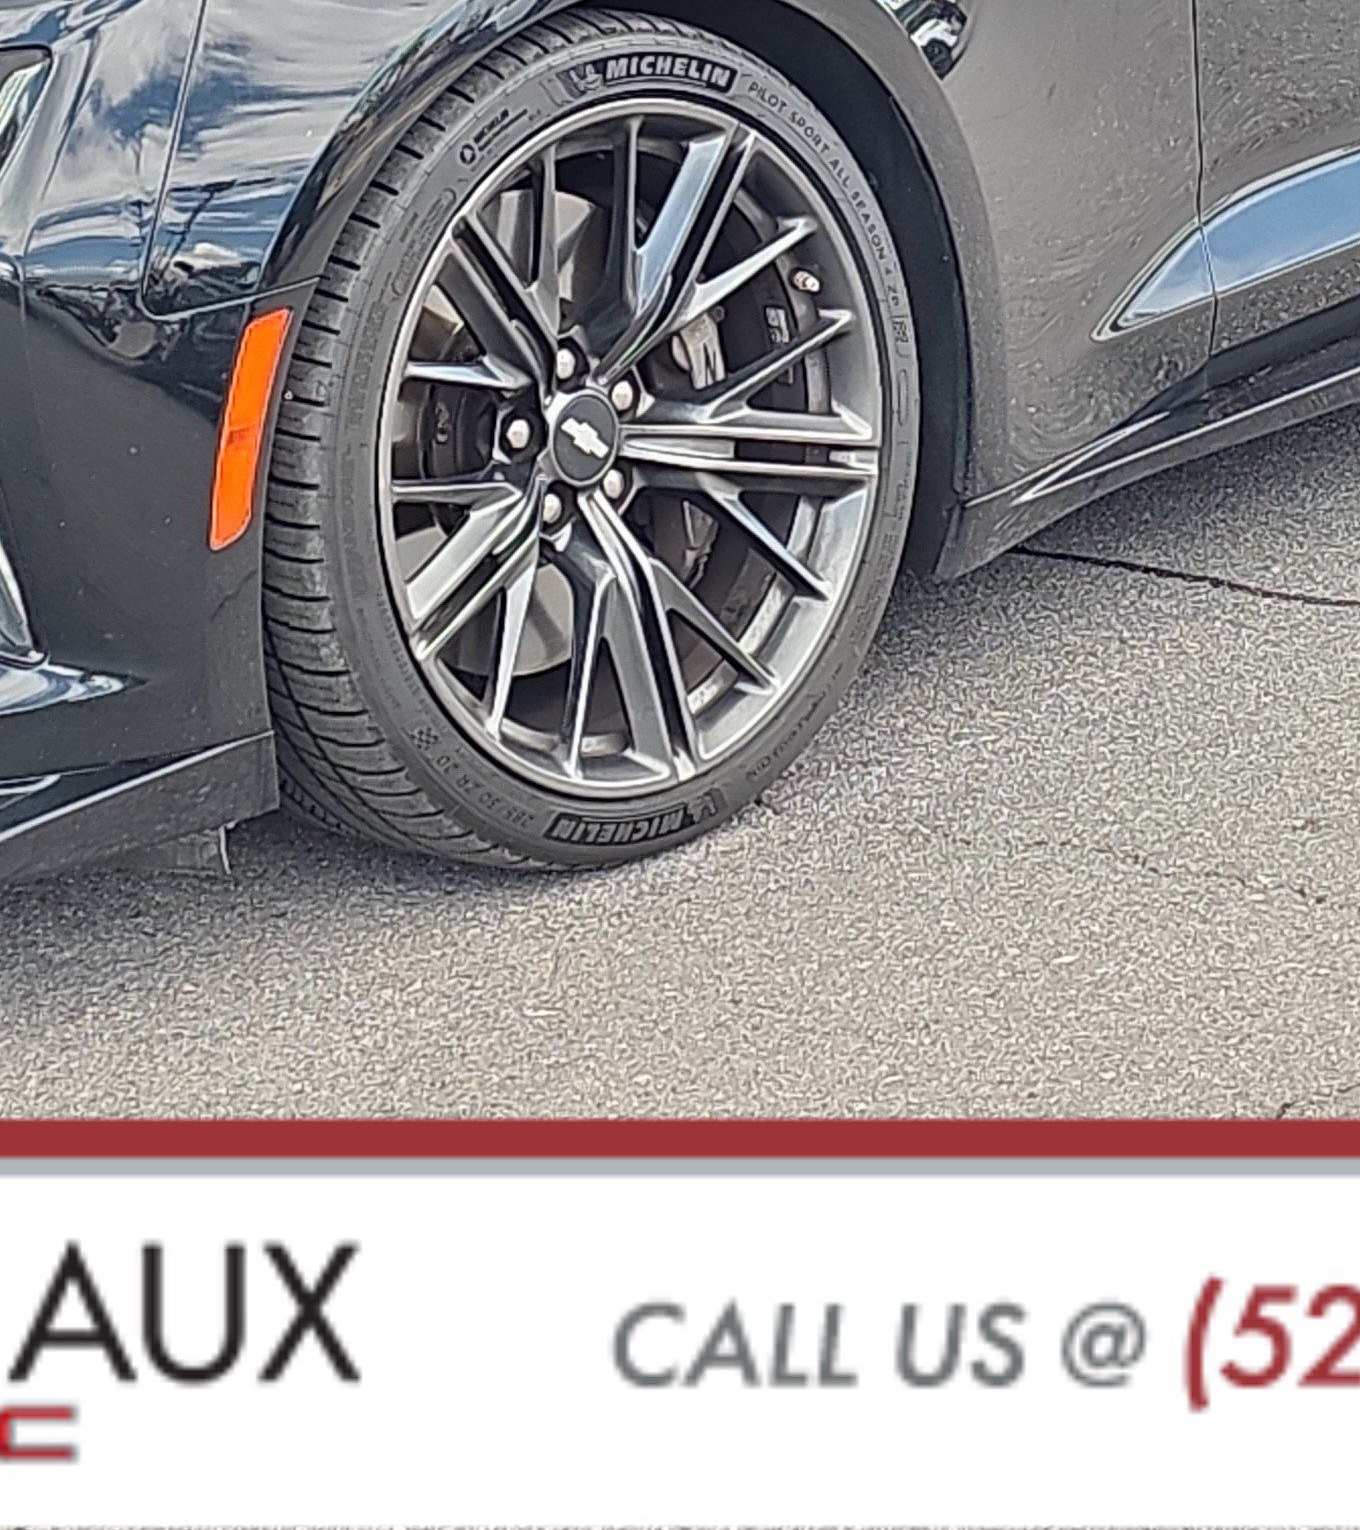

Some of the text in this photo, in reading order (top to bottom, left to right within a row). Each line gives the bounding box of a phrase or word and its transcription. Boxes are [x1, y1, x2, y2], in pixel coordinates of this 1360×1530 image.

[605, 54, 731, 88] MICHELIN
[748, 81, 788, 114] PILOT
[790, 108, 830, 153] SPORT
[828, 158, 852, 189] ALL
[850, 191, 886, 261] SEASON
[551, 806, 684, 843] MICHELIN
